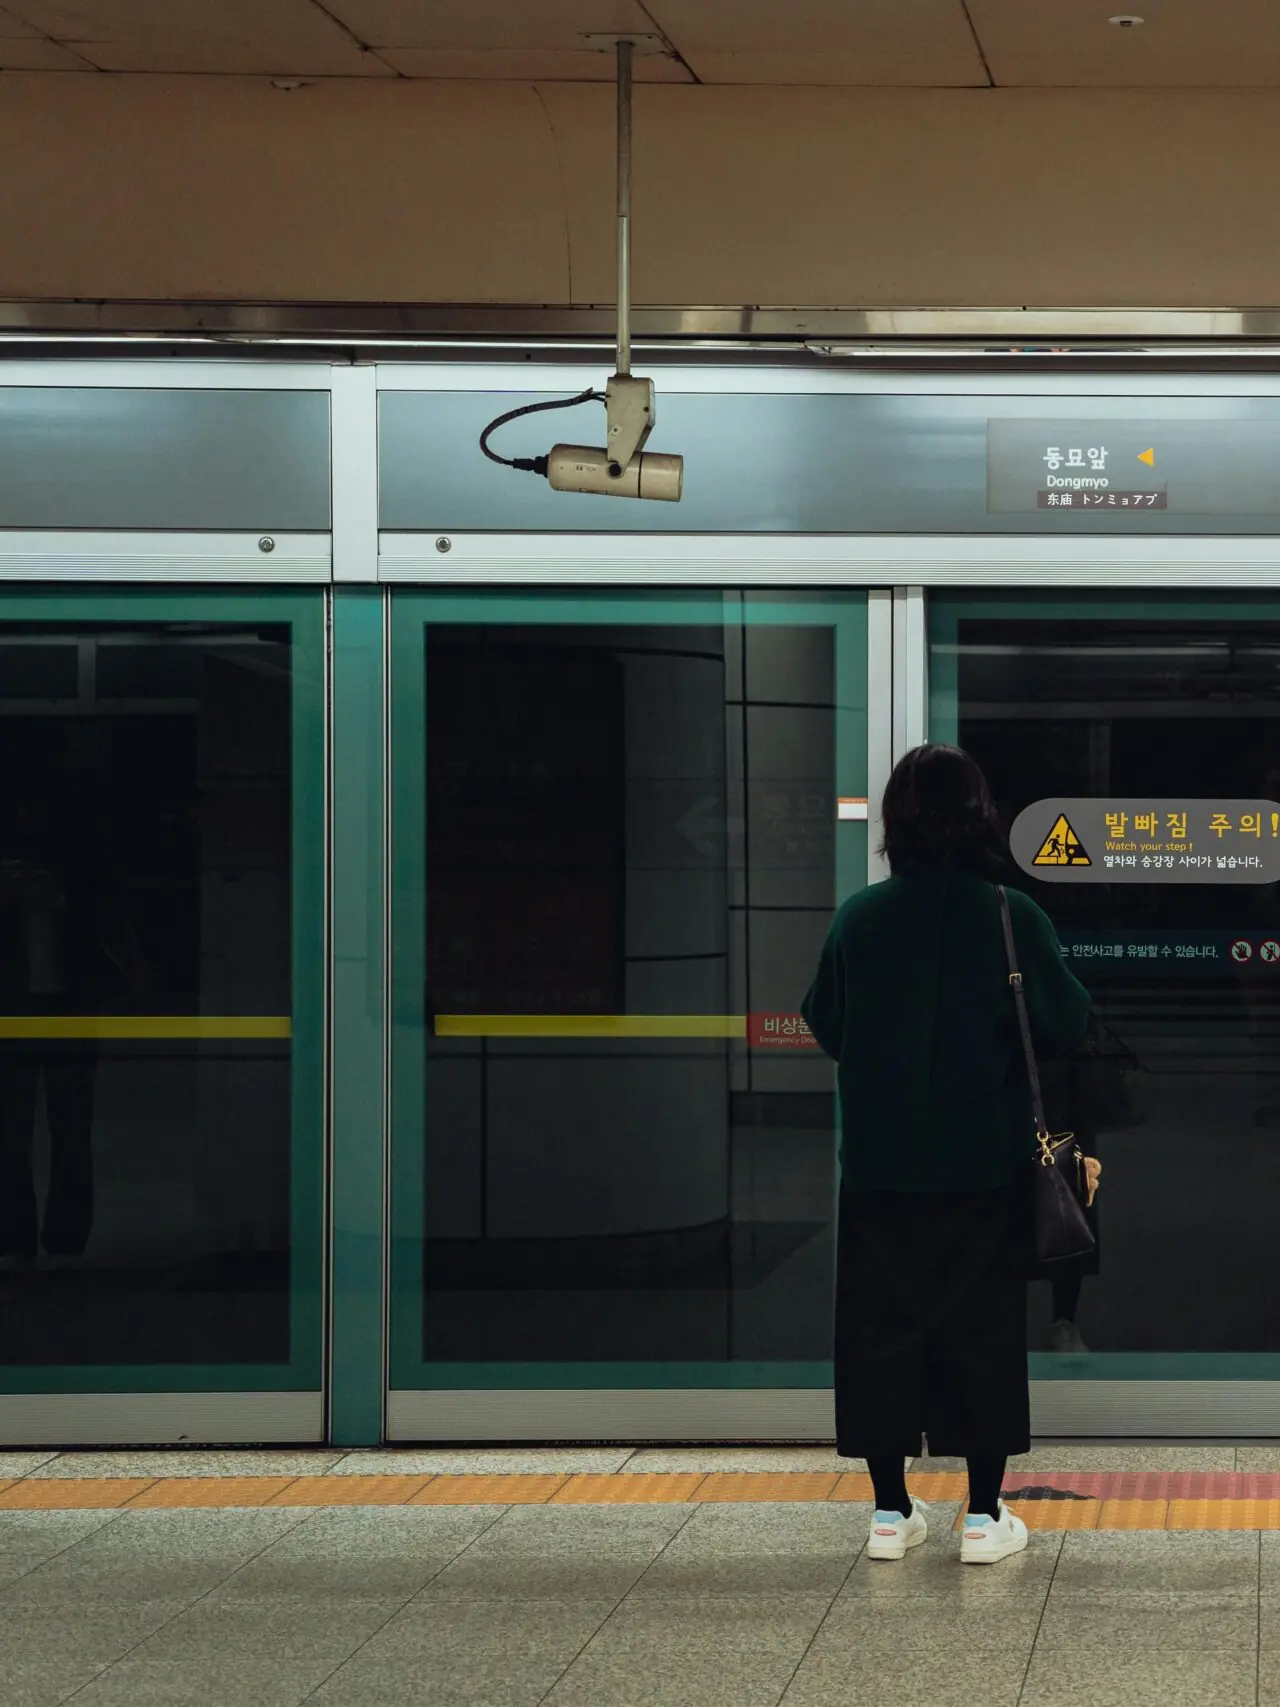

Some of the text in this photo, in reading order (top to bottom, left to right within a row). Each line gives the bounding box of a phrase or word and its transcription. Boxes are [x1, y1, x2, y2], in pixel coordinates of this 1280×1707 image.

[1042, 446, 1109, 470] 동묘앞
[1046, 475, 1109, 490] Dongmyo
[1105, 812, 1280, 838] 발빠짐 주의!
[1105, 841, 1137, 851] Watch
[1140, 843, 1162, 853] your
[1103, 855, 1137, 868] 열차와
[1141, 855, 1175, 868] 승강장
[1178, 855, 1212, 868] 사이가
[1072, 944, 1124, 958] 안전사고를
[1127, 944, 1158, 958] 유발할
[1161, 945, 1172, 958] 수
[1175, 944, 1219, 958] 있습니다.
